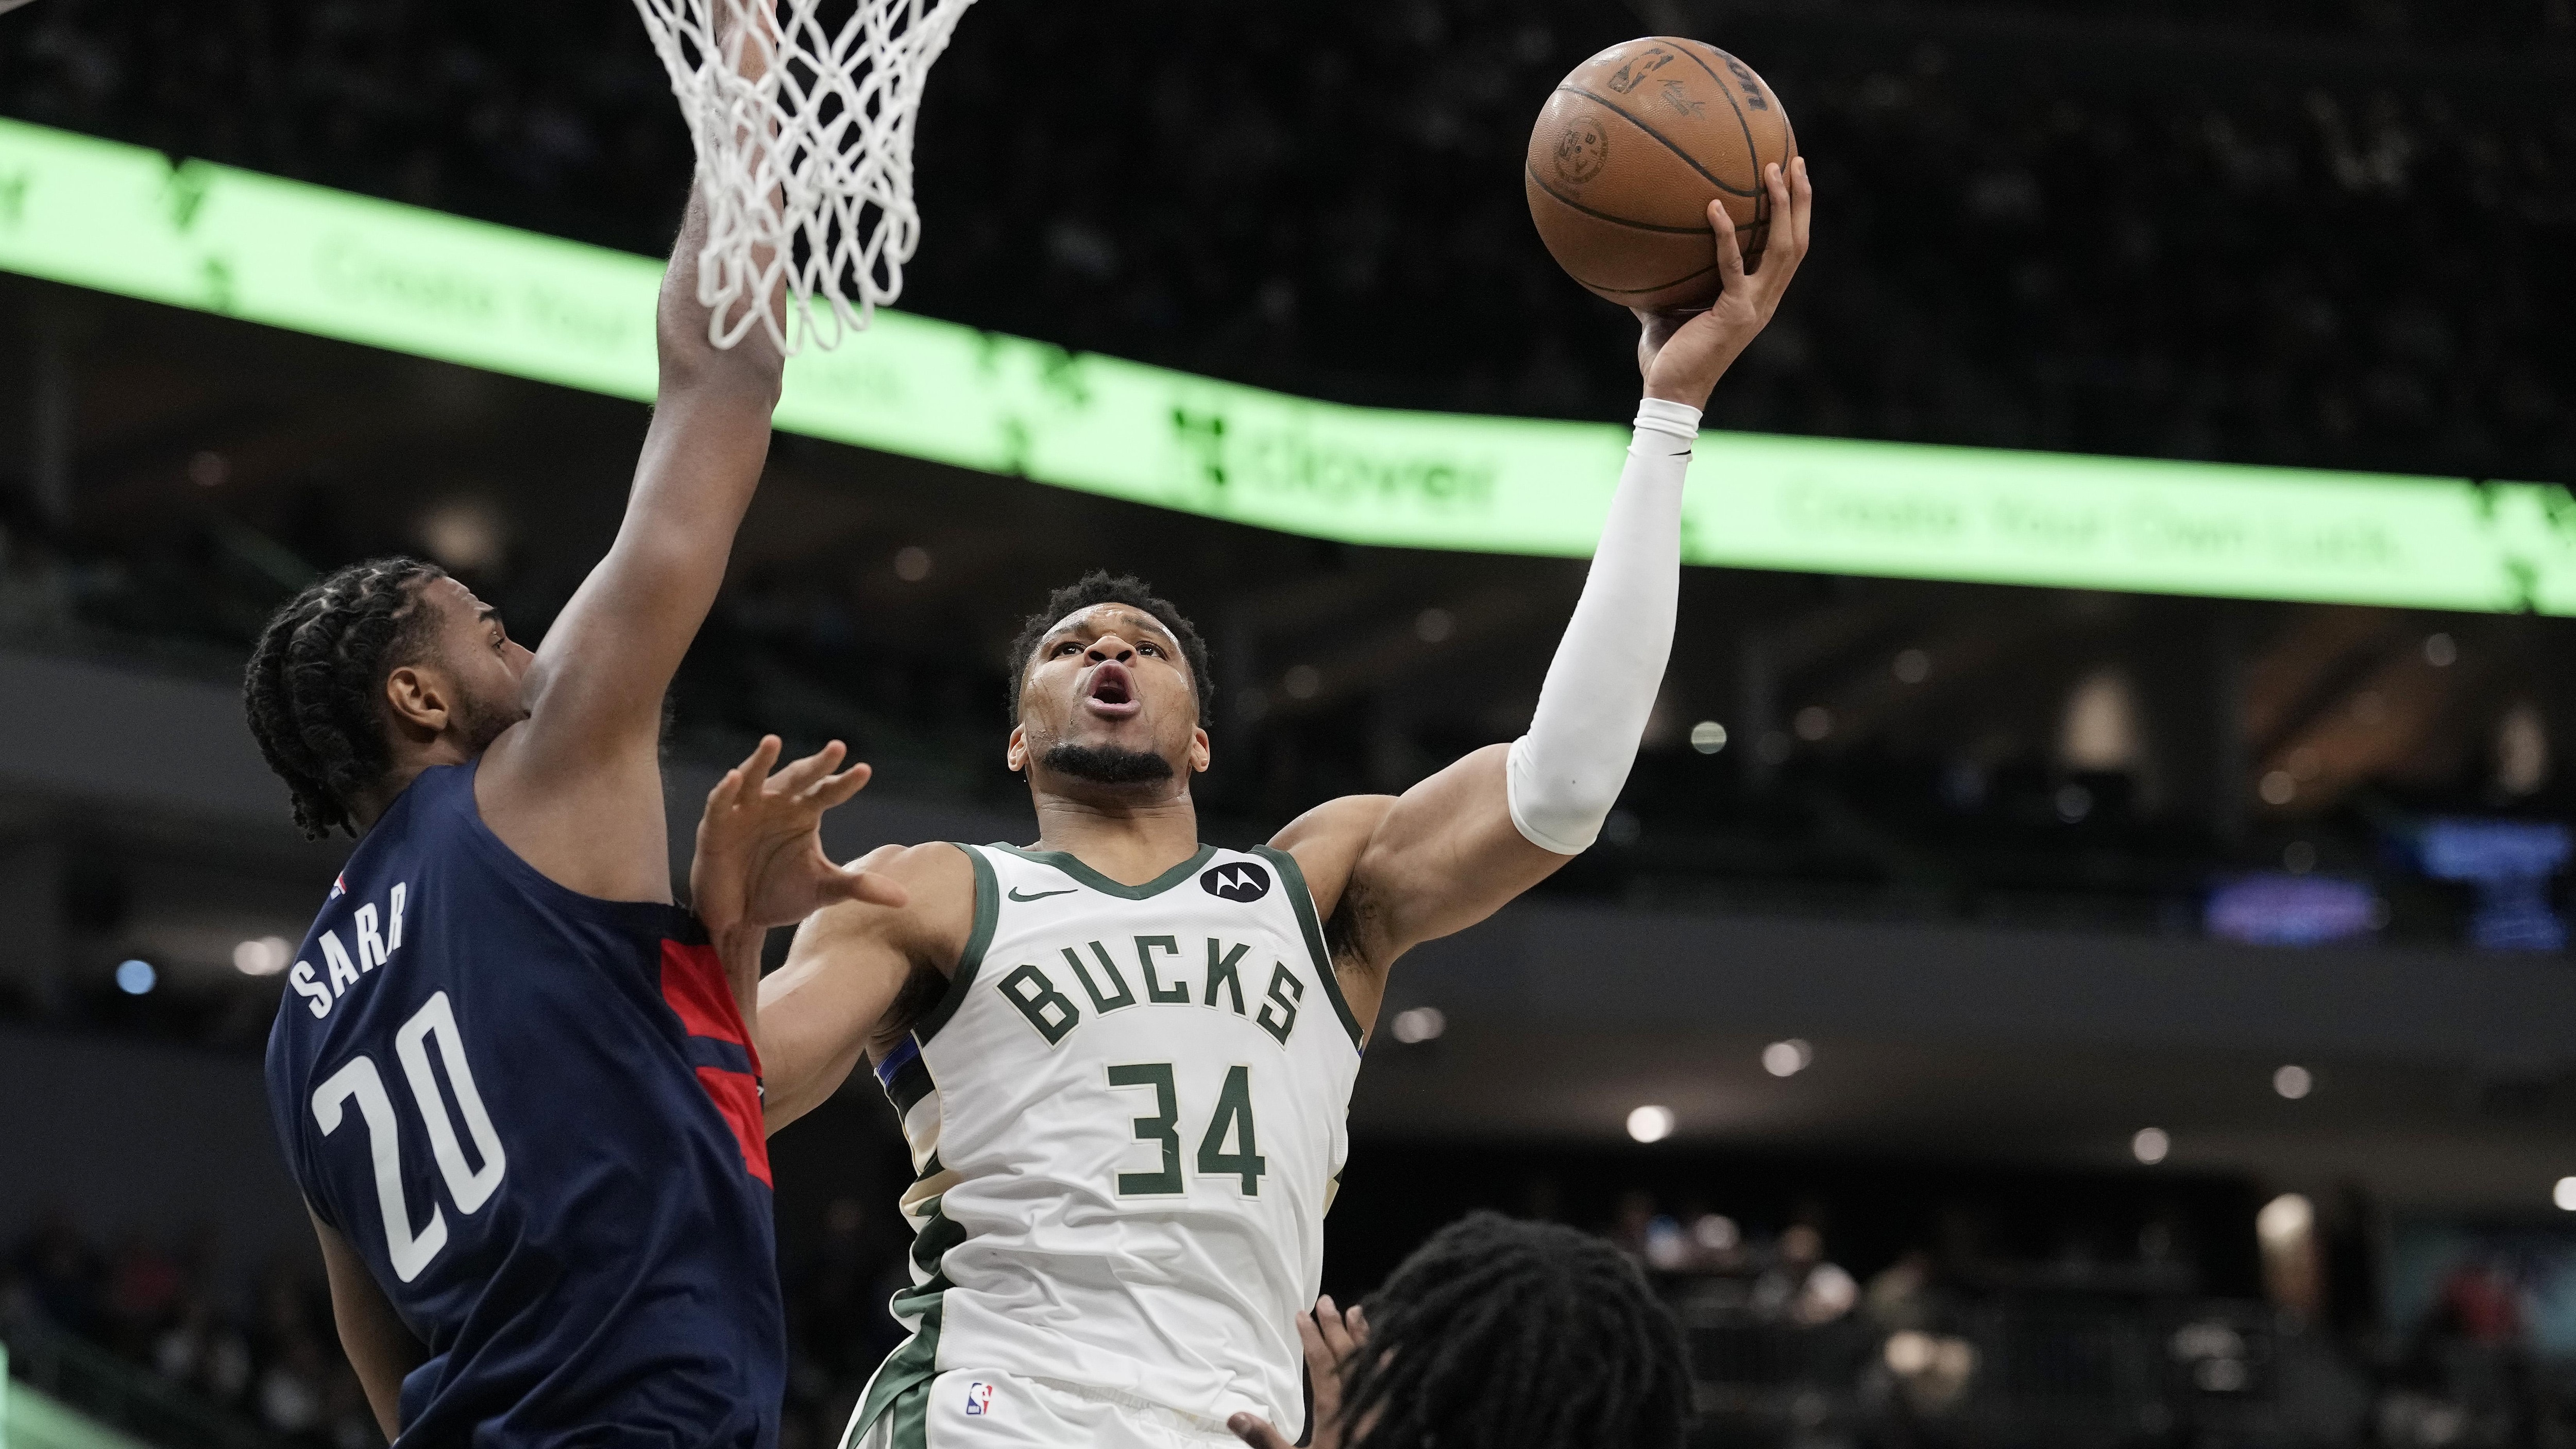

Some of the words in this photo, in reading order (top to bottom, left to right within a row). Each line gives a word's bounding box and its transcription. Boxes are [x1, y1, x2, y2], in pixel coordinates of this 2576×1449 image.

[1249, 408, 1500, 503] clover
[290, 881, 406, 1019] SARR
[993, 934, 1307, 1051] BUCKS
[311, 991, 506, 1283] 20
[1103, 1063, 1270, 1202] 34
